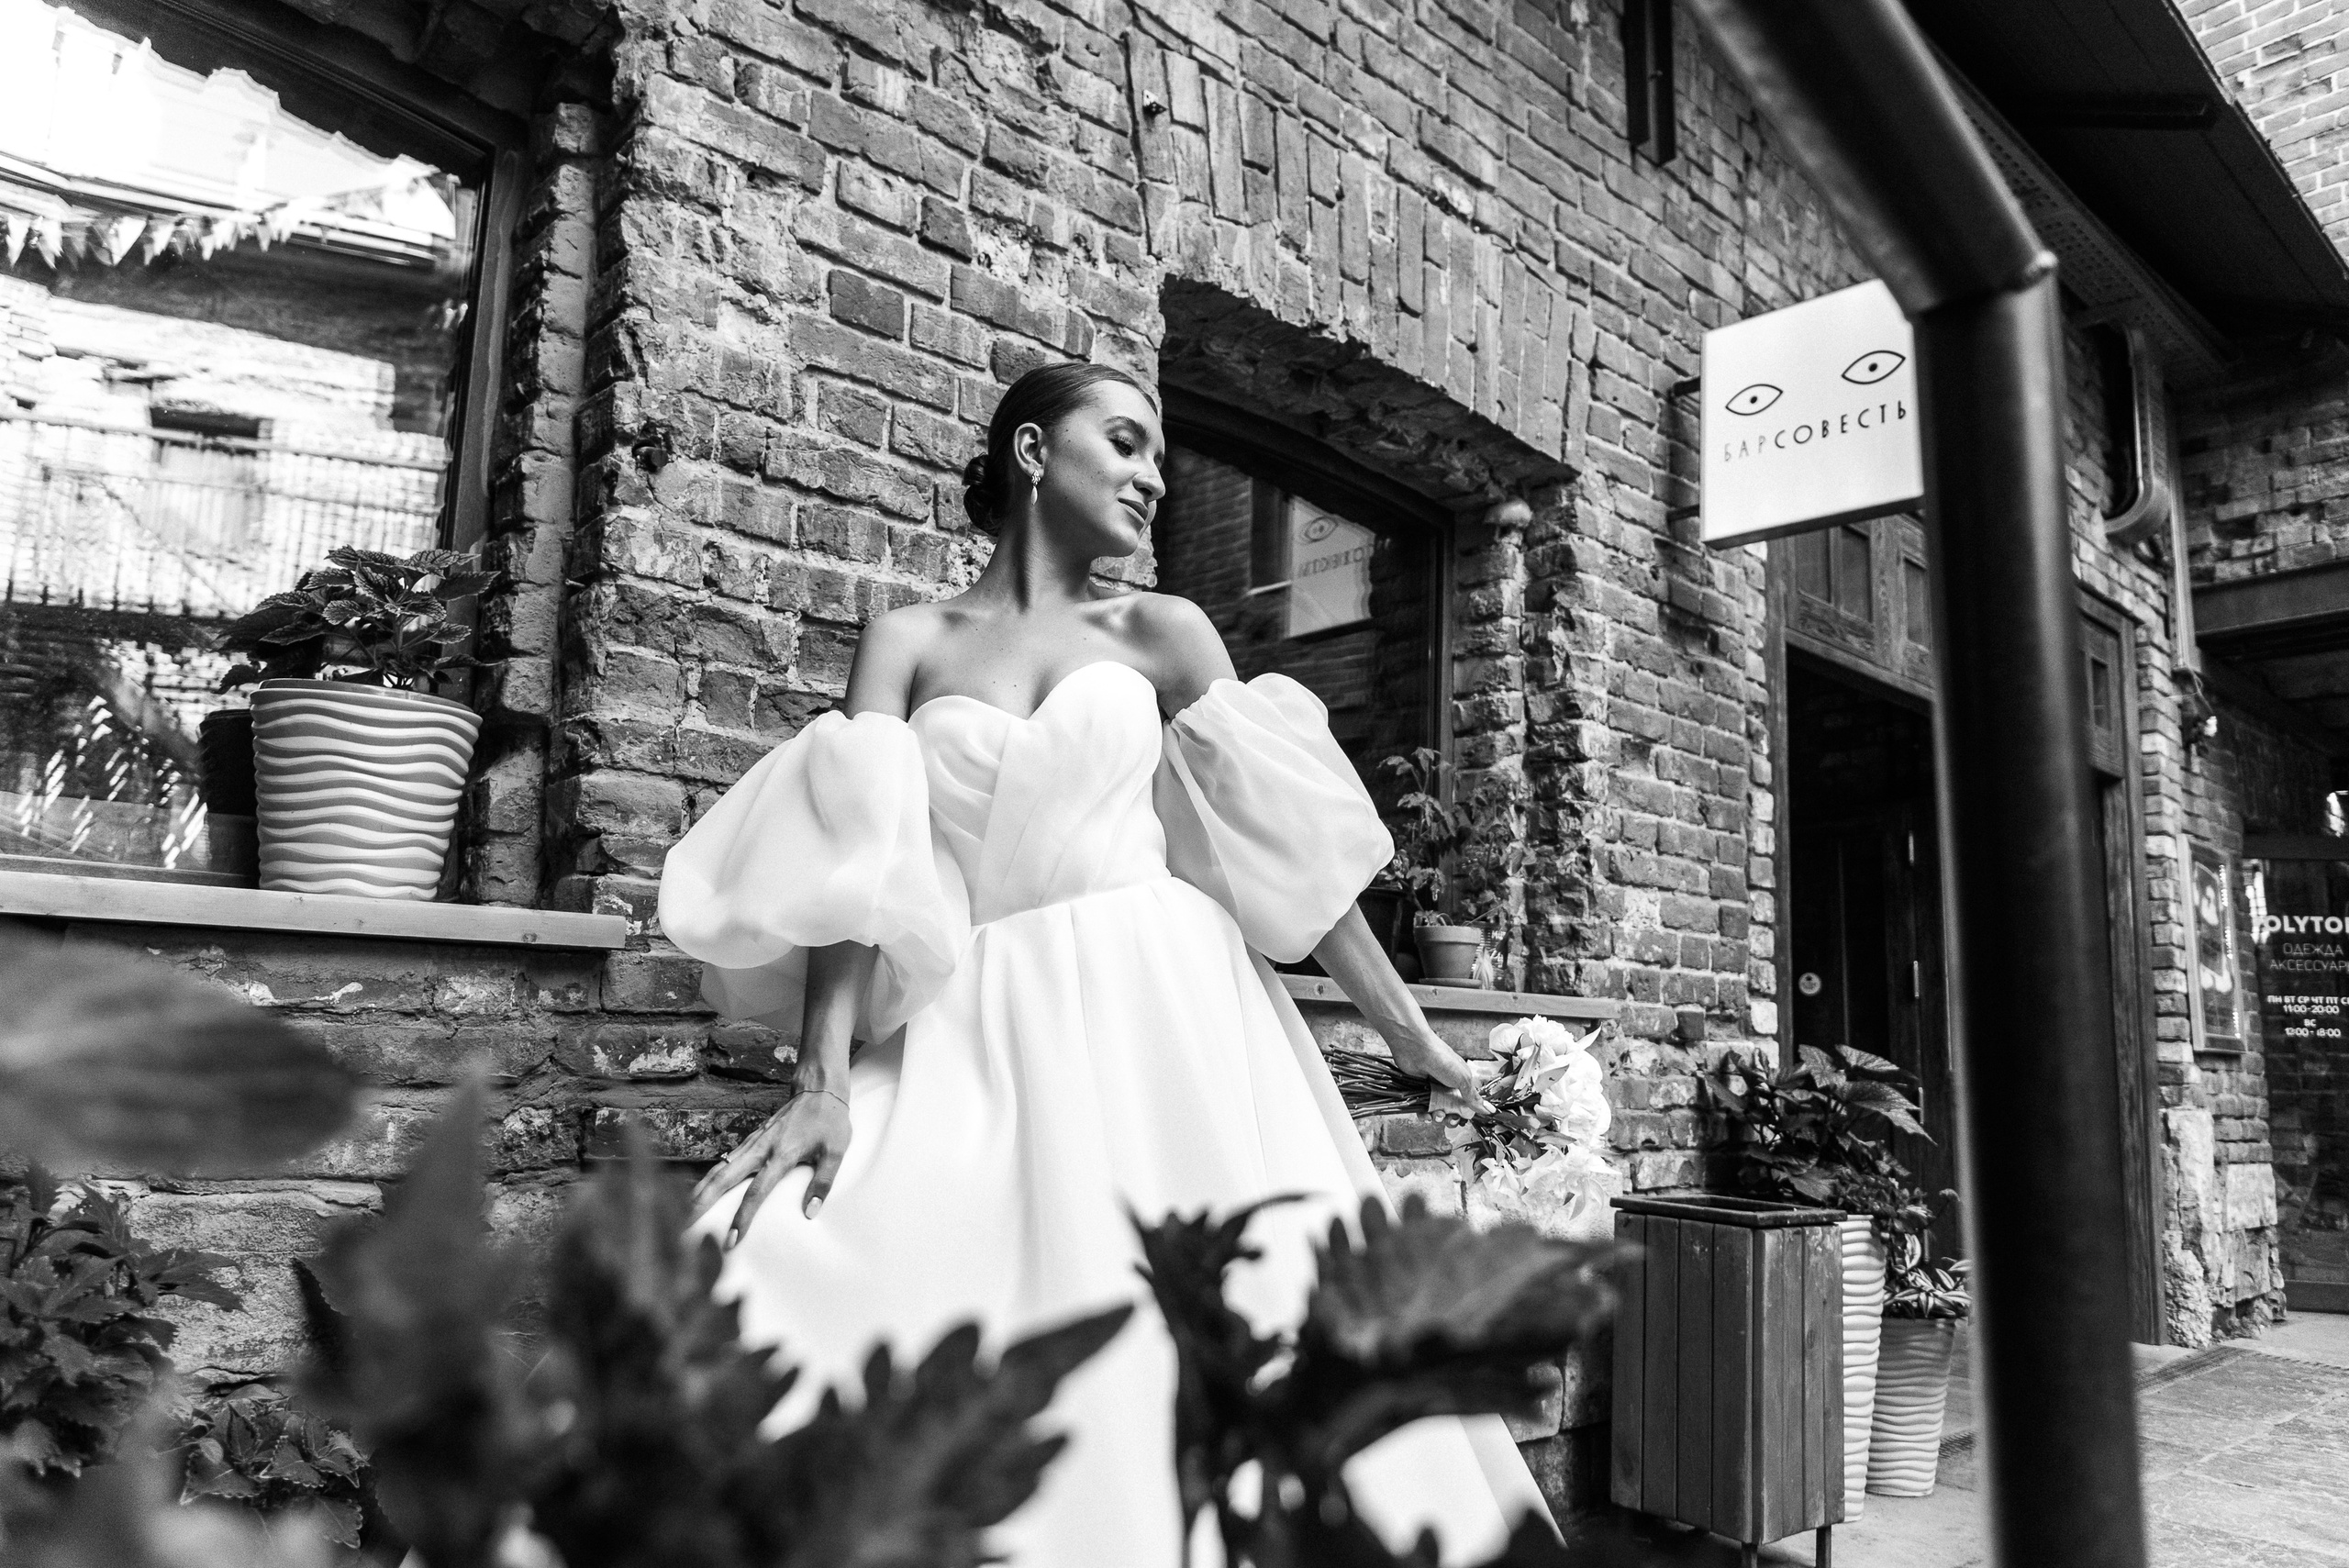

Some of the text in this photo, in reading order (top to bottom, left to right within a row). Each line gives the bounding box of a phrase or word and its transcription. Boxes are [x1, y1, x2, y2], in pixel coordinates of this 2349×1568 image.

[2254, 915, 2349, 933] OLYTO
[2283, 942, 2343, 956] ОДЕЖДА
[2267, 995, 2282, 1004] ПН
[2298, 995, 2310, 1004] СР
[2325, 996, 2338, 1005] ПТ
[2341, 996, 2349, 1006] С
[2303, 1018, 2316, 1028] ВС
